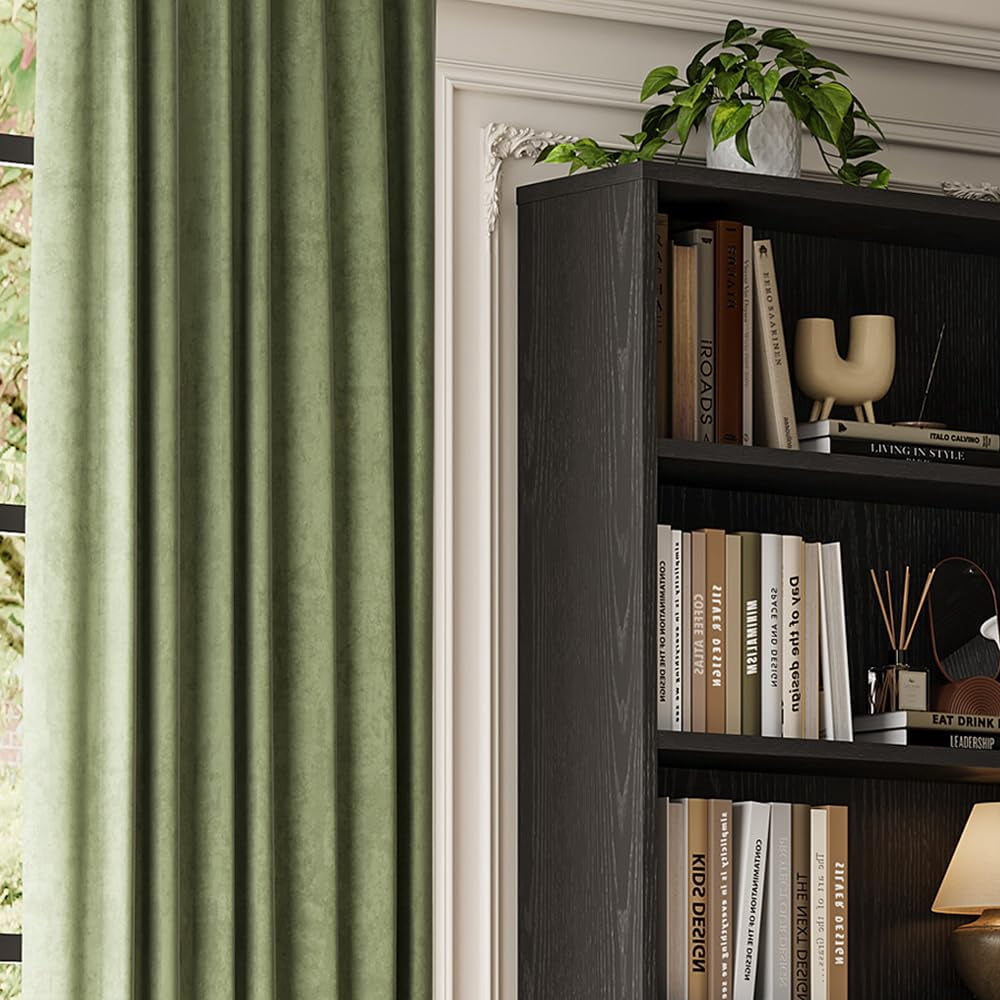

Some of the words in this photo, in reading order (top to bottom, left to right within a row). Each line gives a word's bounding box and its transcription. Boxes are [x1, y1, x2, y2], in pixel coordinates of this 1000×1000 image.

[767, 305, 784, 366] SAARINEN
[929, 432, 949, 441] ITALO
[950, 434, 980, 444] CALVINO
[870, 442, 911, 455] LIVING
[913, 447, 926, 456] IN
[929, 449, 965, 461] STYLE
[932, 714, 954, 725] EAT
[957, 716, 994, 729] DRINK
[950, 734, 995, 750] LEADERSHIP
